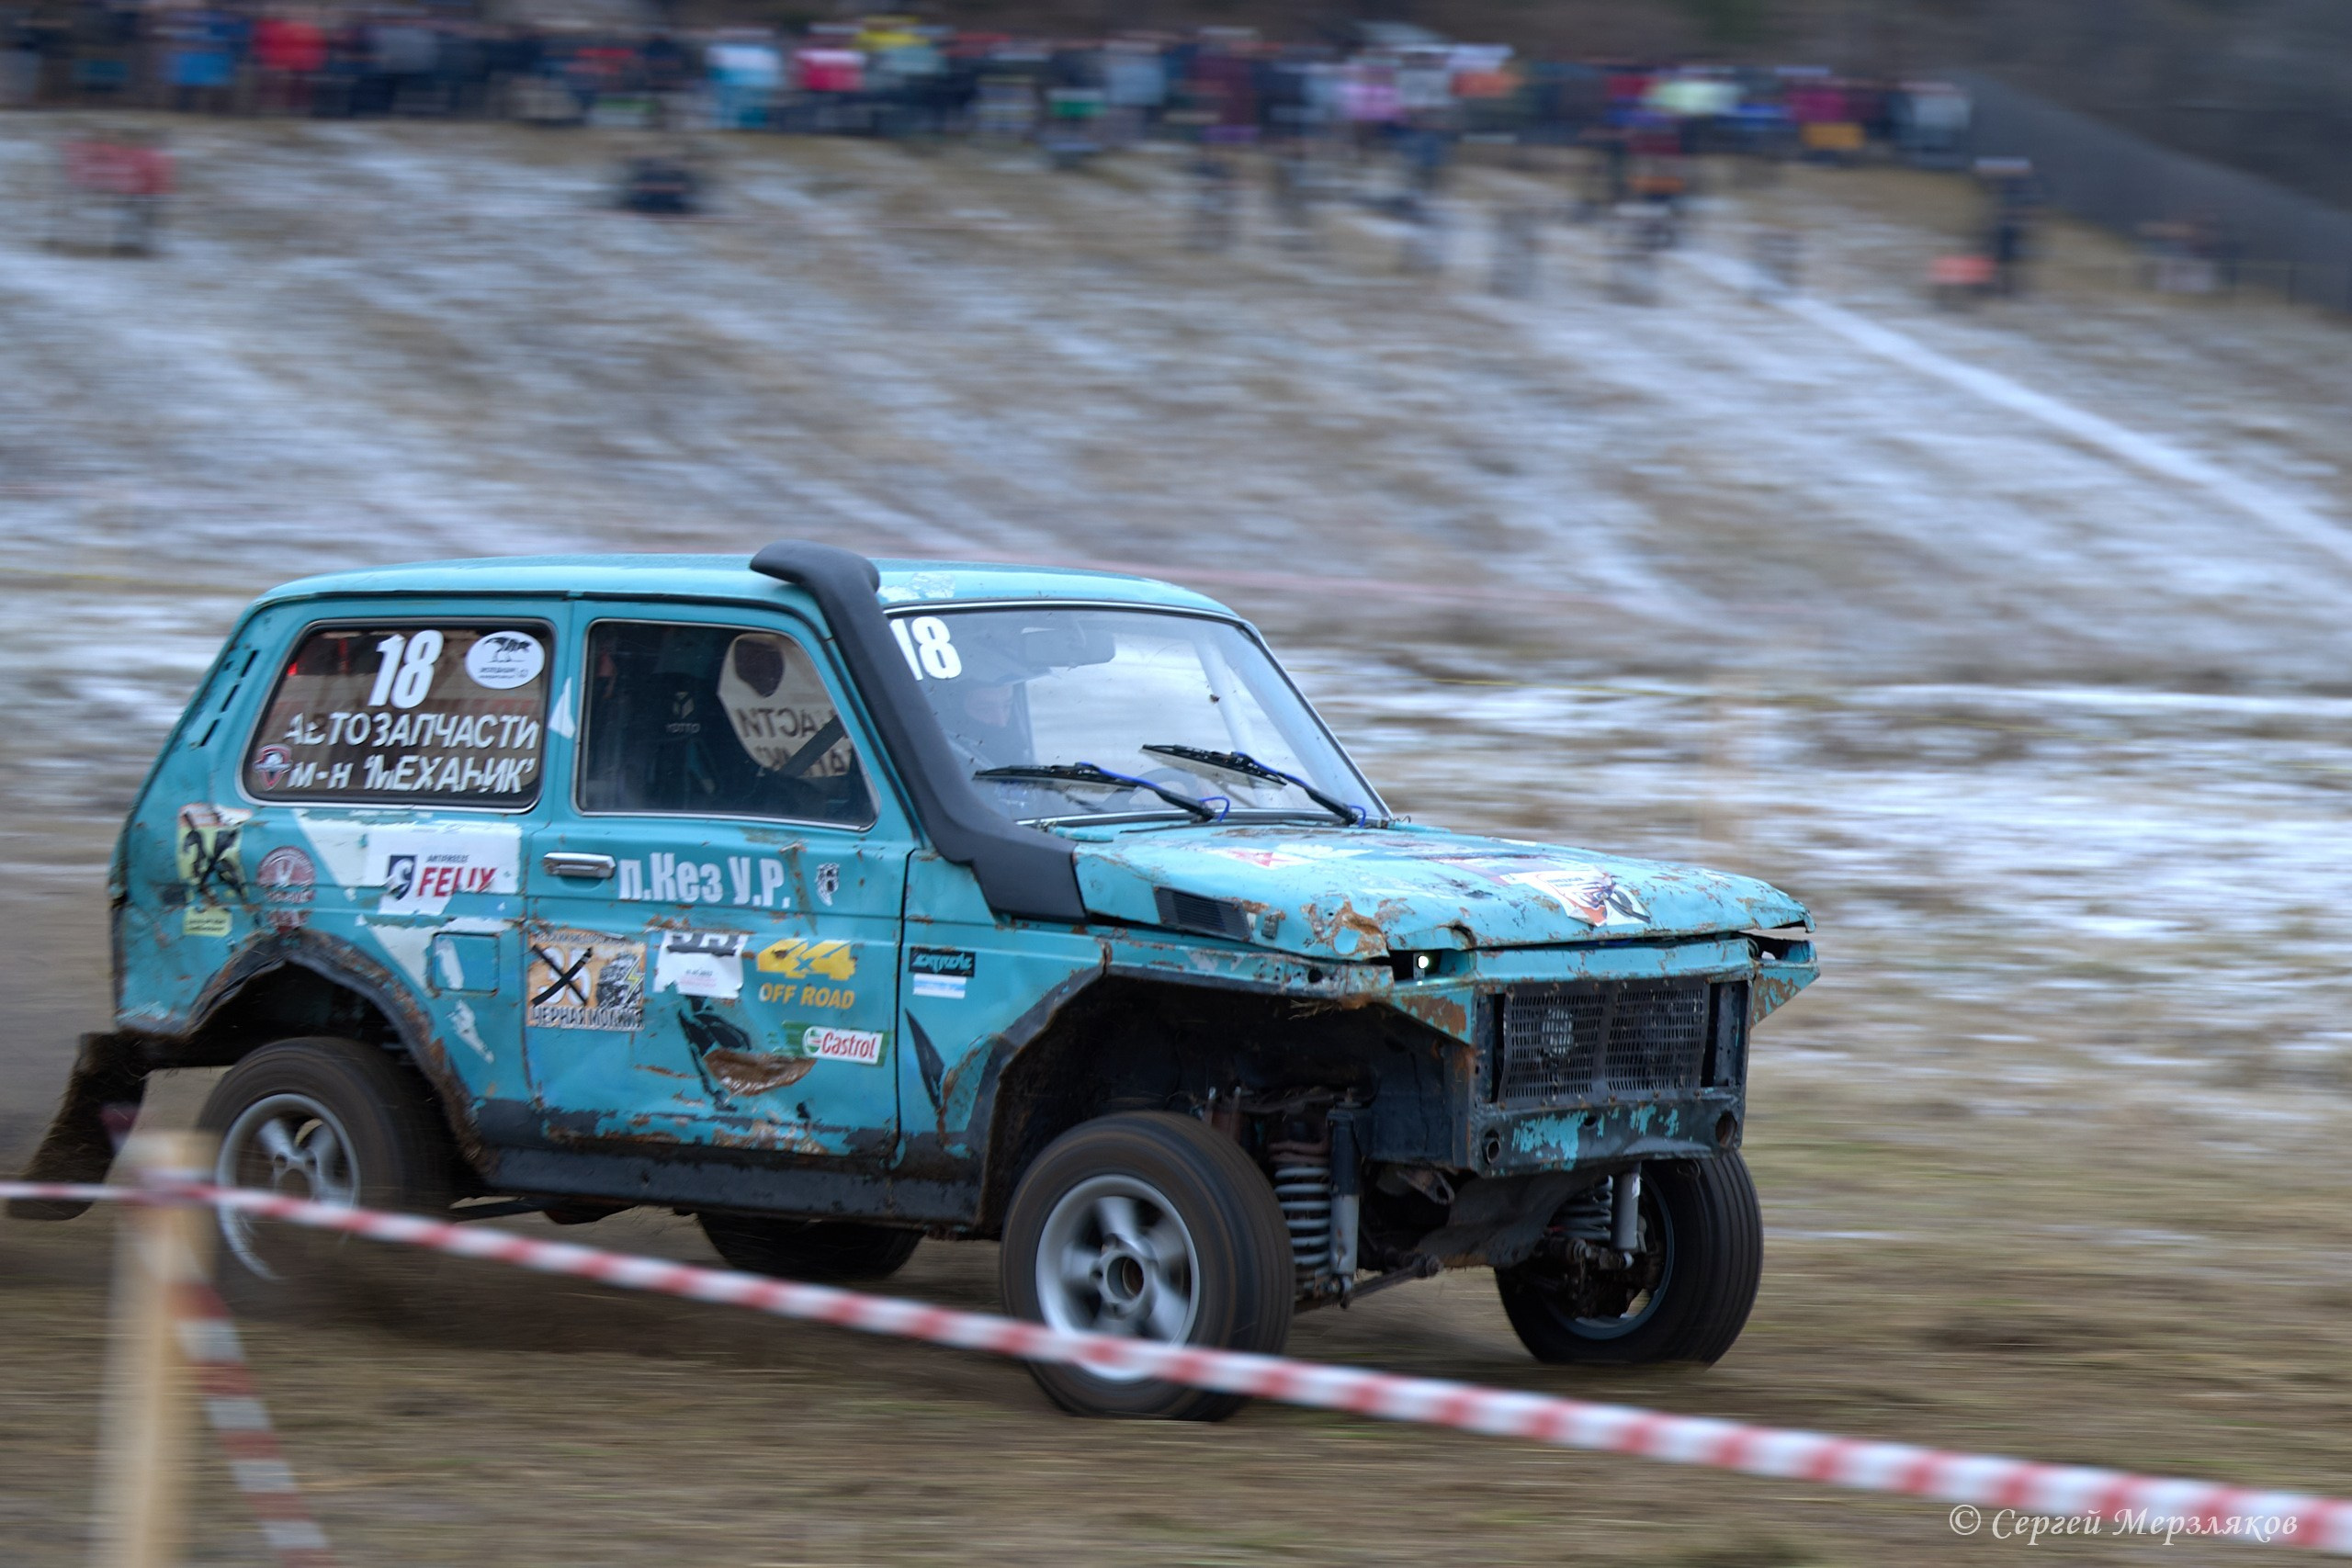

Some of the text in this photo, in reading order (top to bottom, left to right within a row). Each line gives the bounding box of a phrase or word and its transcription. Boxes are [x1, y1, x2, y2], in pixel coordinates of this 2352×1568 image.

[368, 629, 444, 709] 18
[888, 616, 962, 681] 18
[759, 982, 855, 1010] OFF ROAD
[822, 1031, 876, 1059] Castrol
